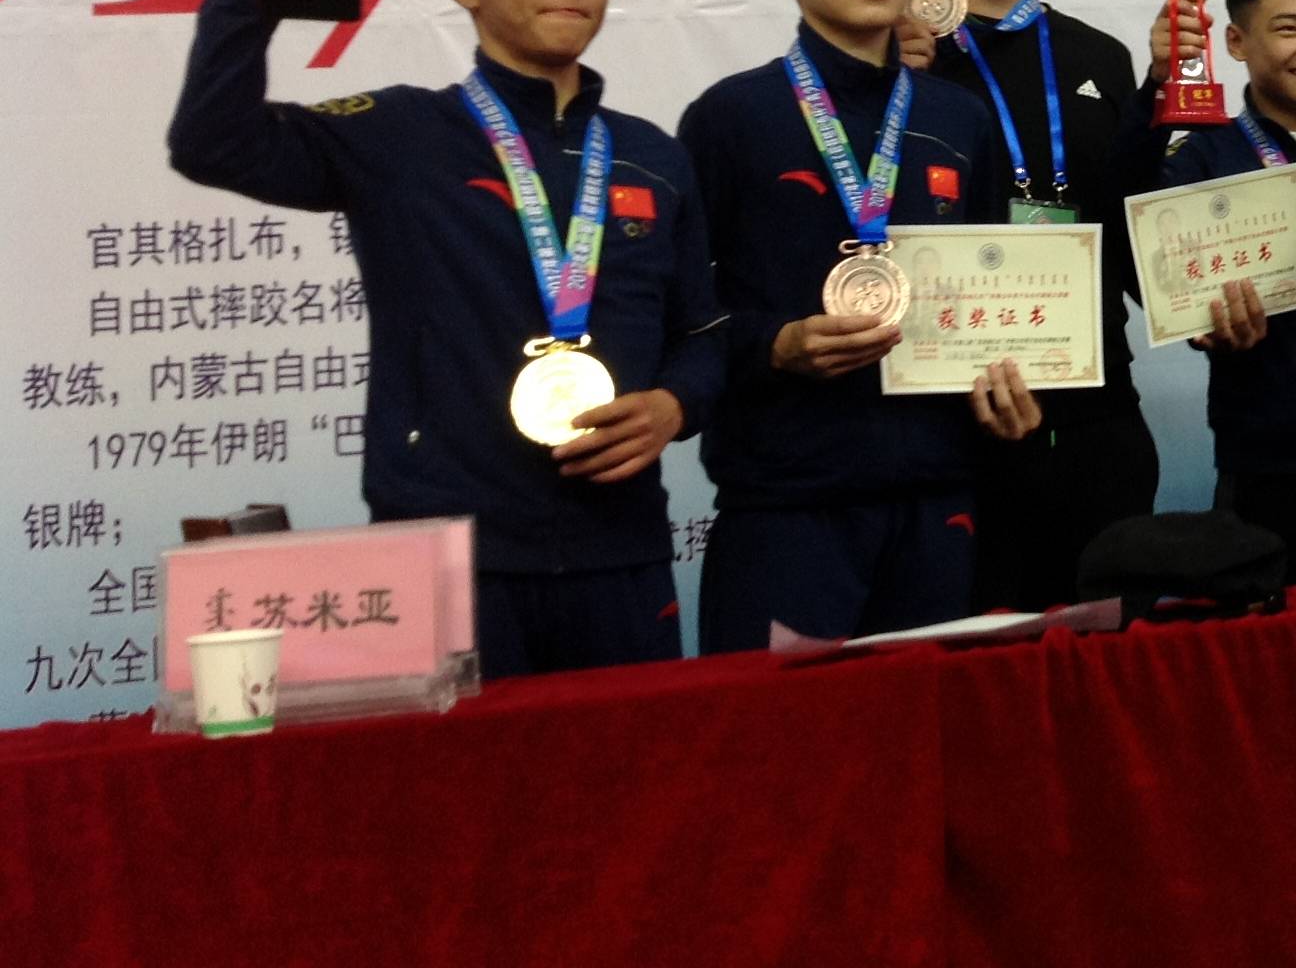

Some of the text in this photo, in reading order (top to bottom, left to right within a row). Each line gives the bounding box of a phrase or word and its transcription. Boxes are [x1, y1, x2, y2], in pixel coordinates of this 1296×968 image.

[1185, 241, 1273, 280] 获奖证书
[90, 278, 367, 336] 自由式摔跤名将
[937, 304, 1048, 330] 获奖证书
[250, 588, 400, 632] 苏米亚
[25, 635, 158, 695] 九次全
